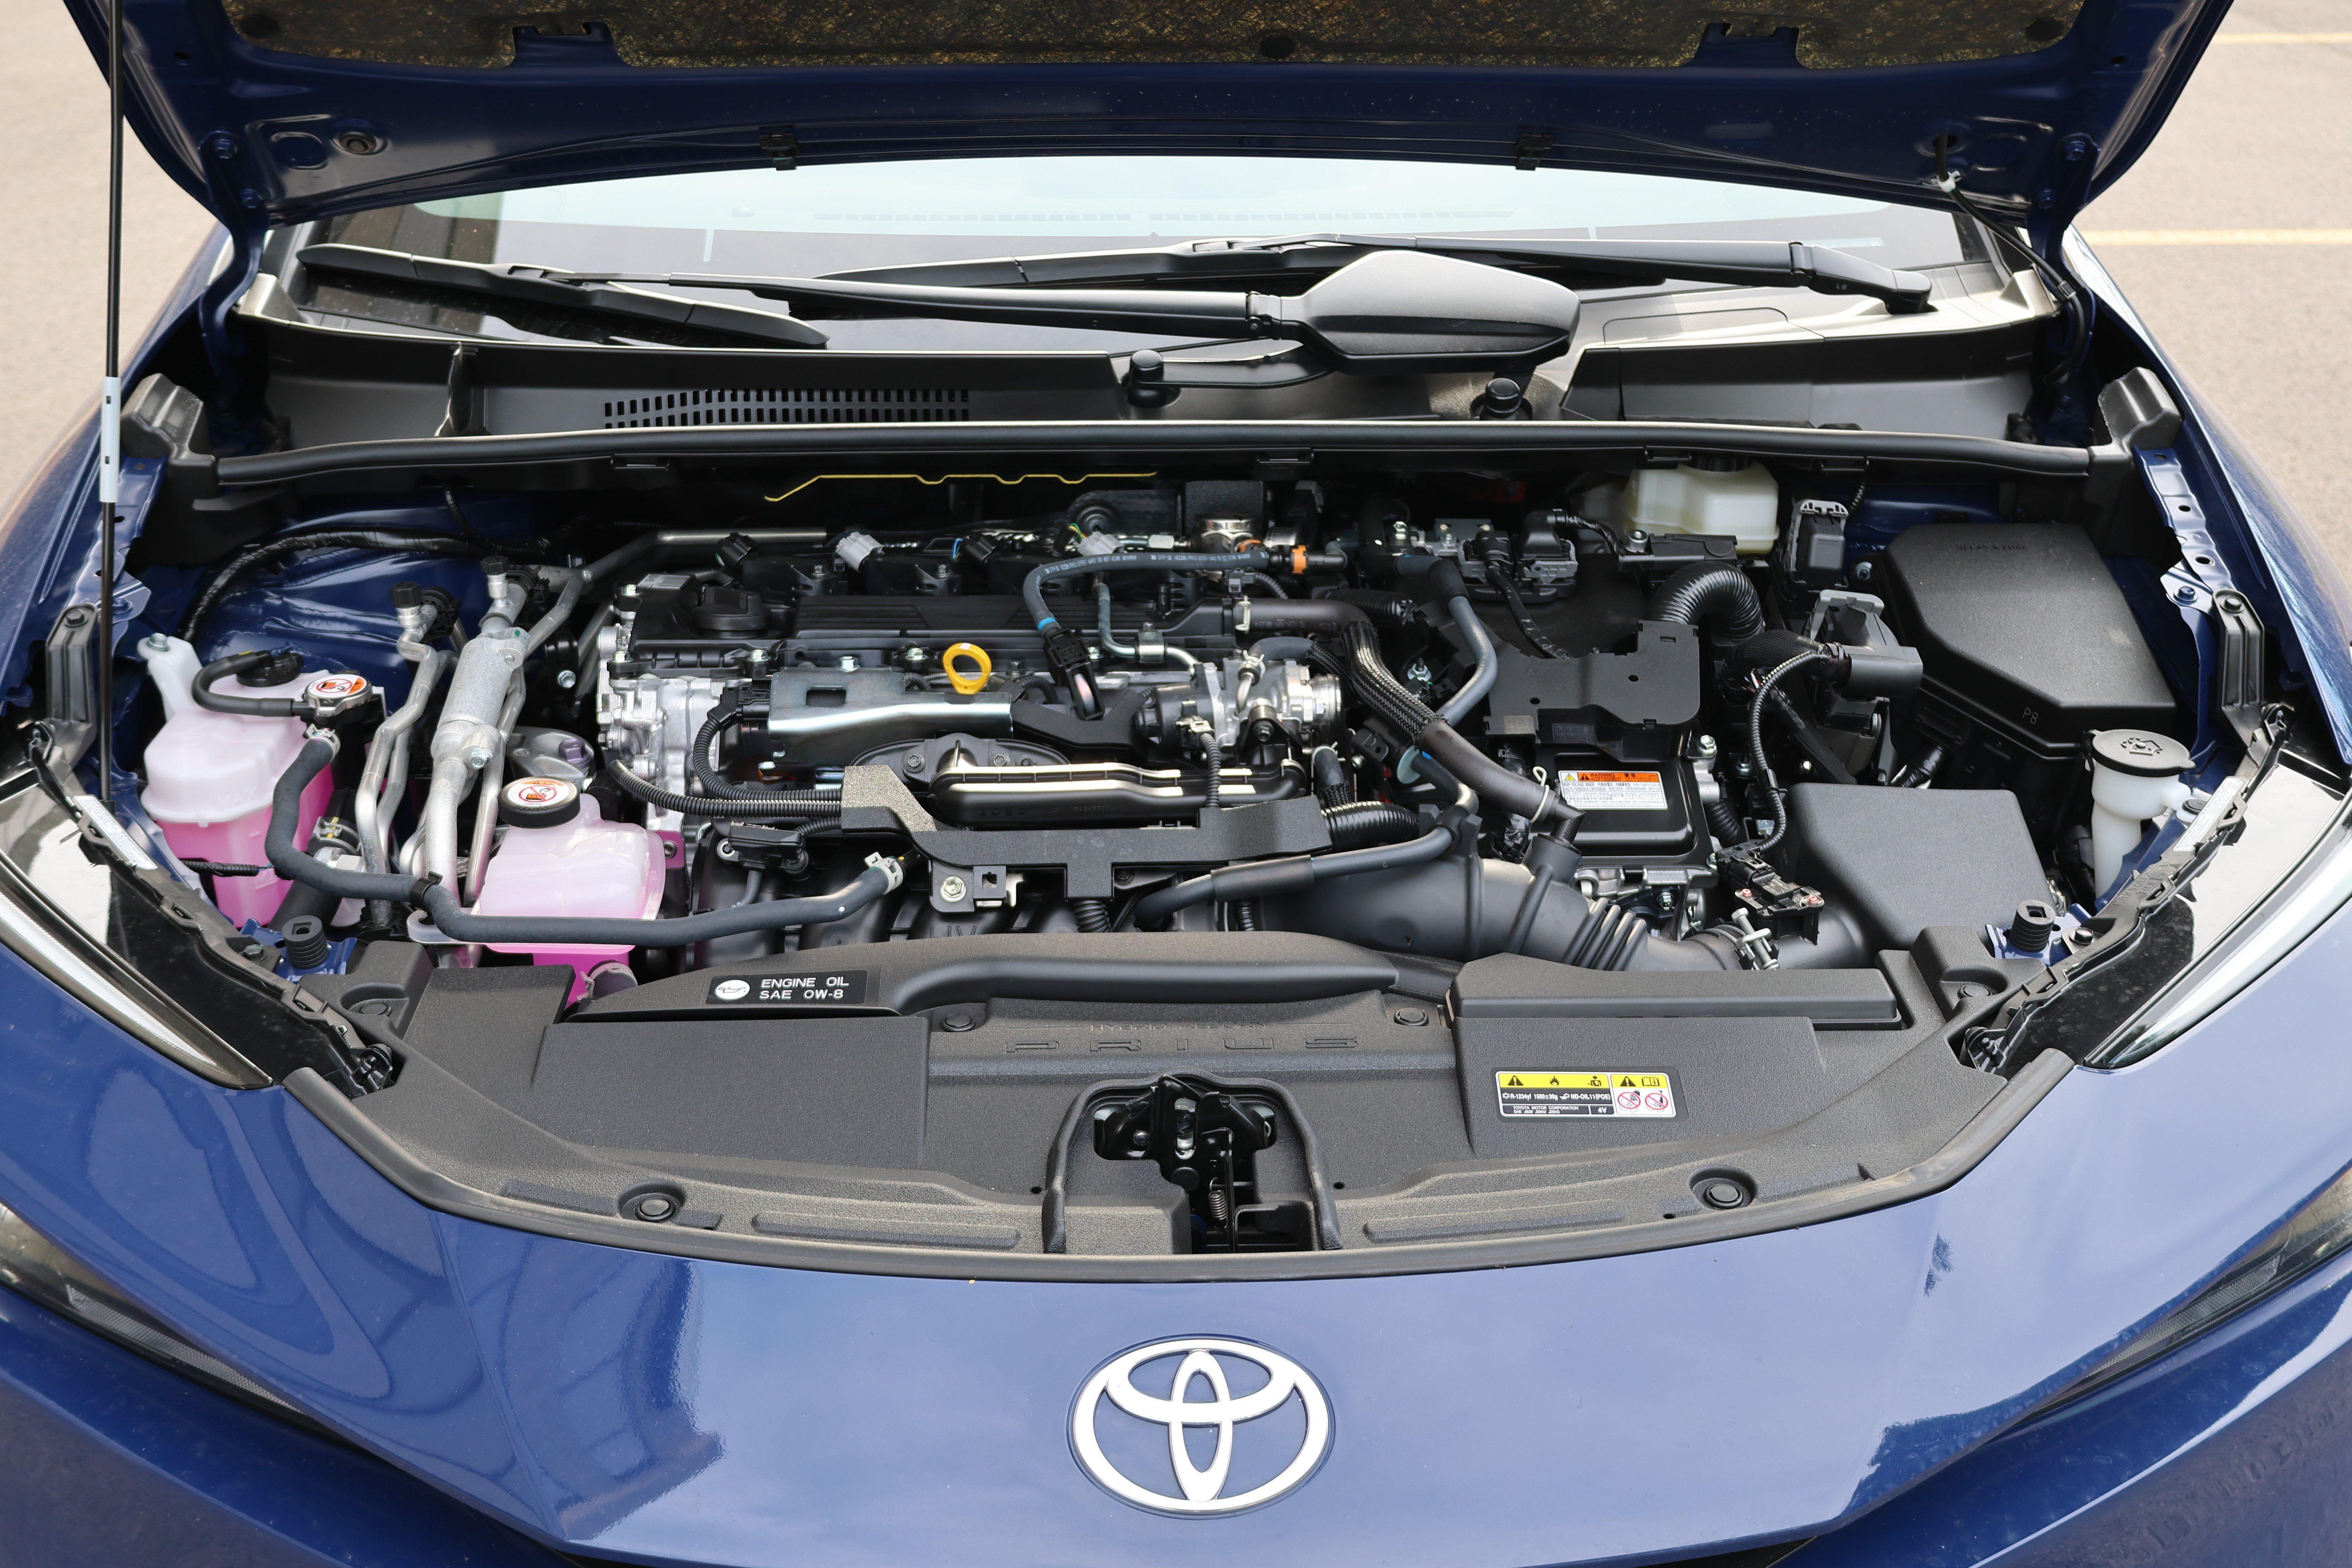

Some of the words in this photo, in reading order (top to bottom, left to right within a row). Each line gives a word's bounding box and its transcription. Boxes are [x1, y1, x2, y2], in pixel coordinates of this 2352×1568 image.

[2022, 707, 2038, 724] P8
[761, 978, 816, 988] ENGINE
[826, 976, 849, 987] OIL
[759, 990, 793, 1000] SAE
[1005, 1036, 1358, 1053] PRIUS
